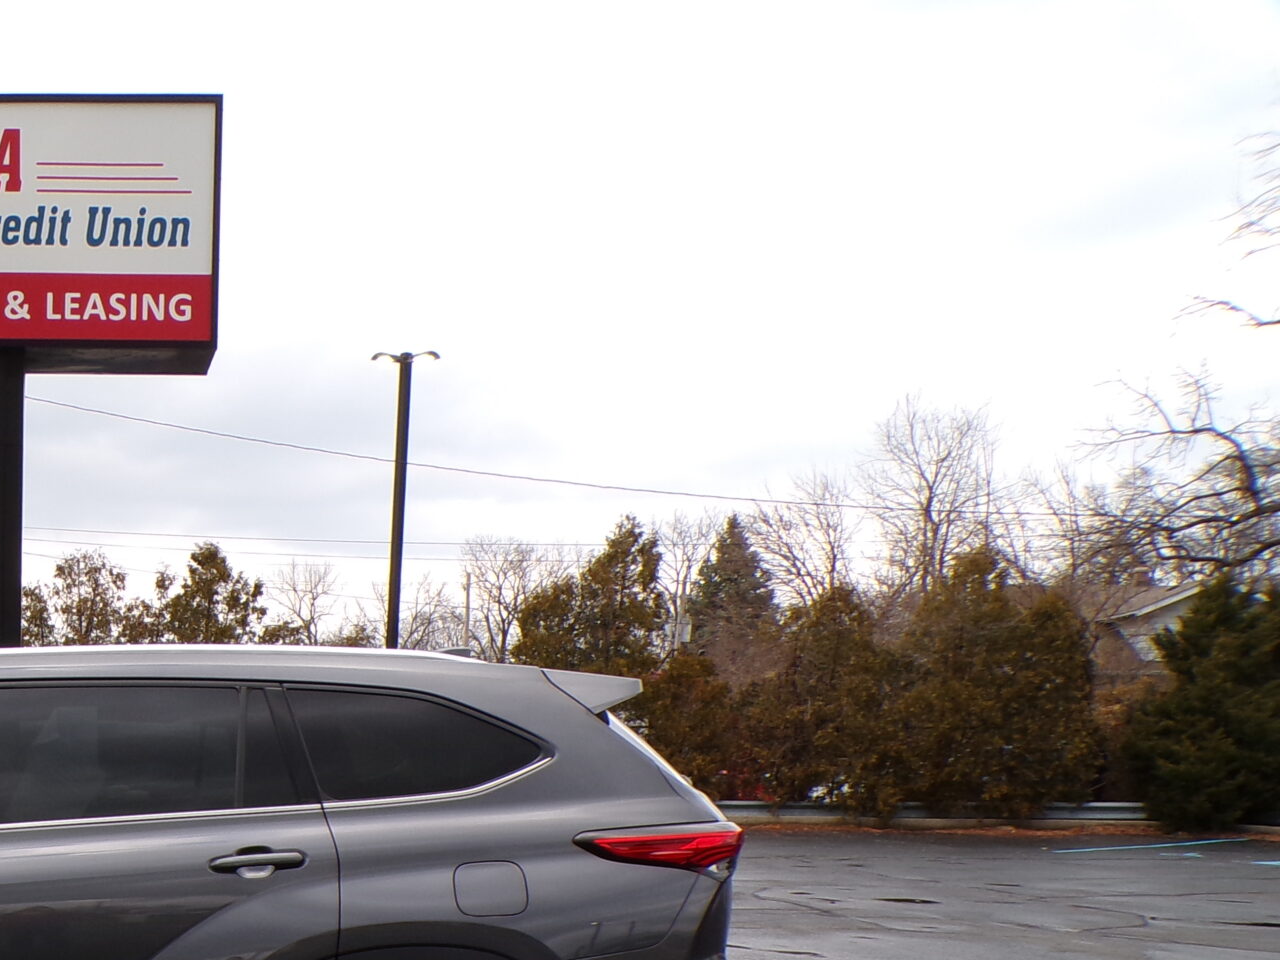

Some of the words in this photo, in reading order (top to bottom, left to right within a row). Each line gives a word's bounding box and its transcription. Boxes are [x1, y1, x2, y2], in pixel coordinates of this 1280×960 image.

[86, 206, 191, 246] Union
[4, 290, 31, 320] &
[46, 292, 192, 322] LEASING
